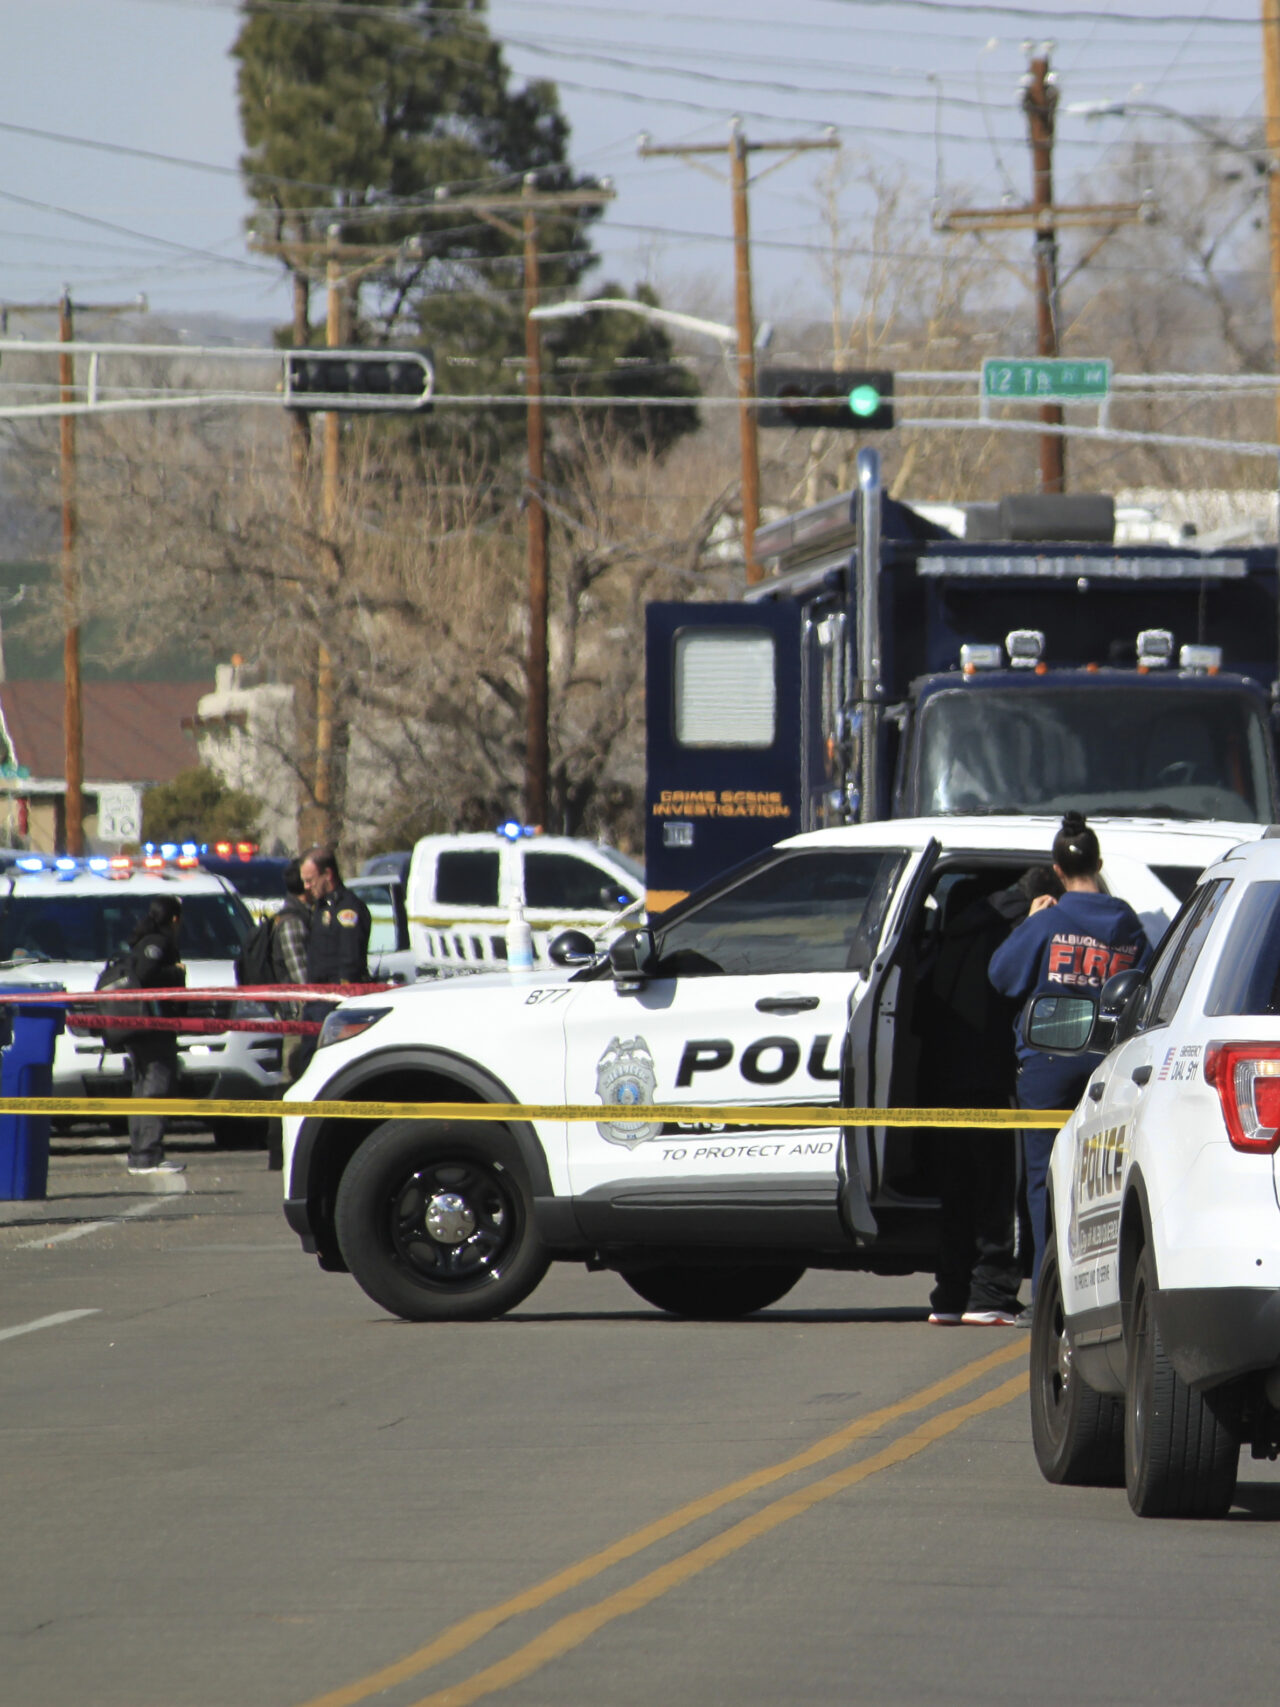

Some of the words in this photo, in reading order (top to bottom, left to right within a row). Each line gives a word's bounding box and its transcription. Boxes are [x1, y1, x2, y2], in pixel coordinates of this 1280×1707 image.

[988, 367, 1012, 392] 12
[661, 791, 716, 803] CRIME
[721, 791, 782, 804] SCENE
[652, 804, 791, 817] INVESTIGATION
[1049, 944, 1134, 977] FIRE
[525, 988, 572, 1005] 877
[662, 1149, 687, 1161] TO
[693, 1145, 785, 1160] PROTECT
[789, 1142, 833, 1156] AND
[1080, 1125, 1126, 1204] POLICE
